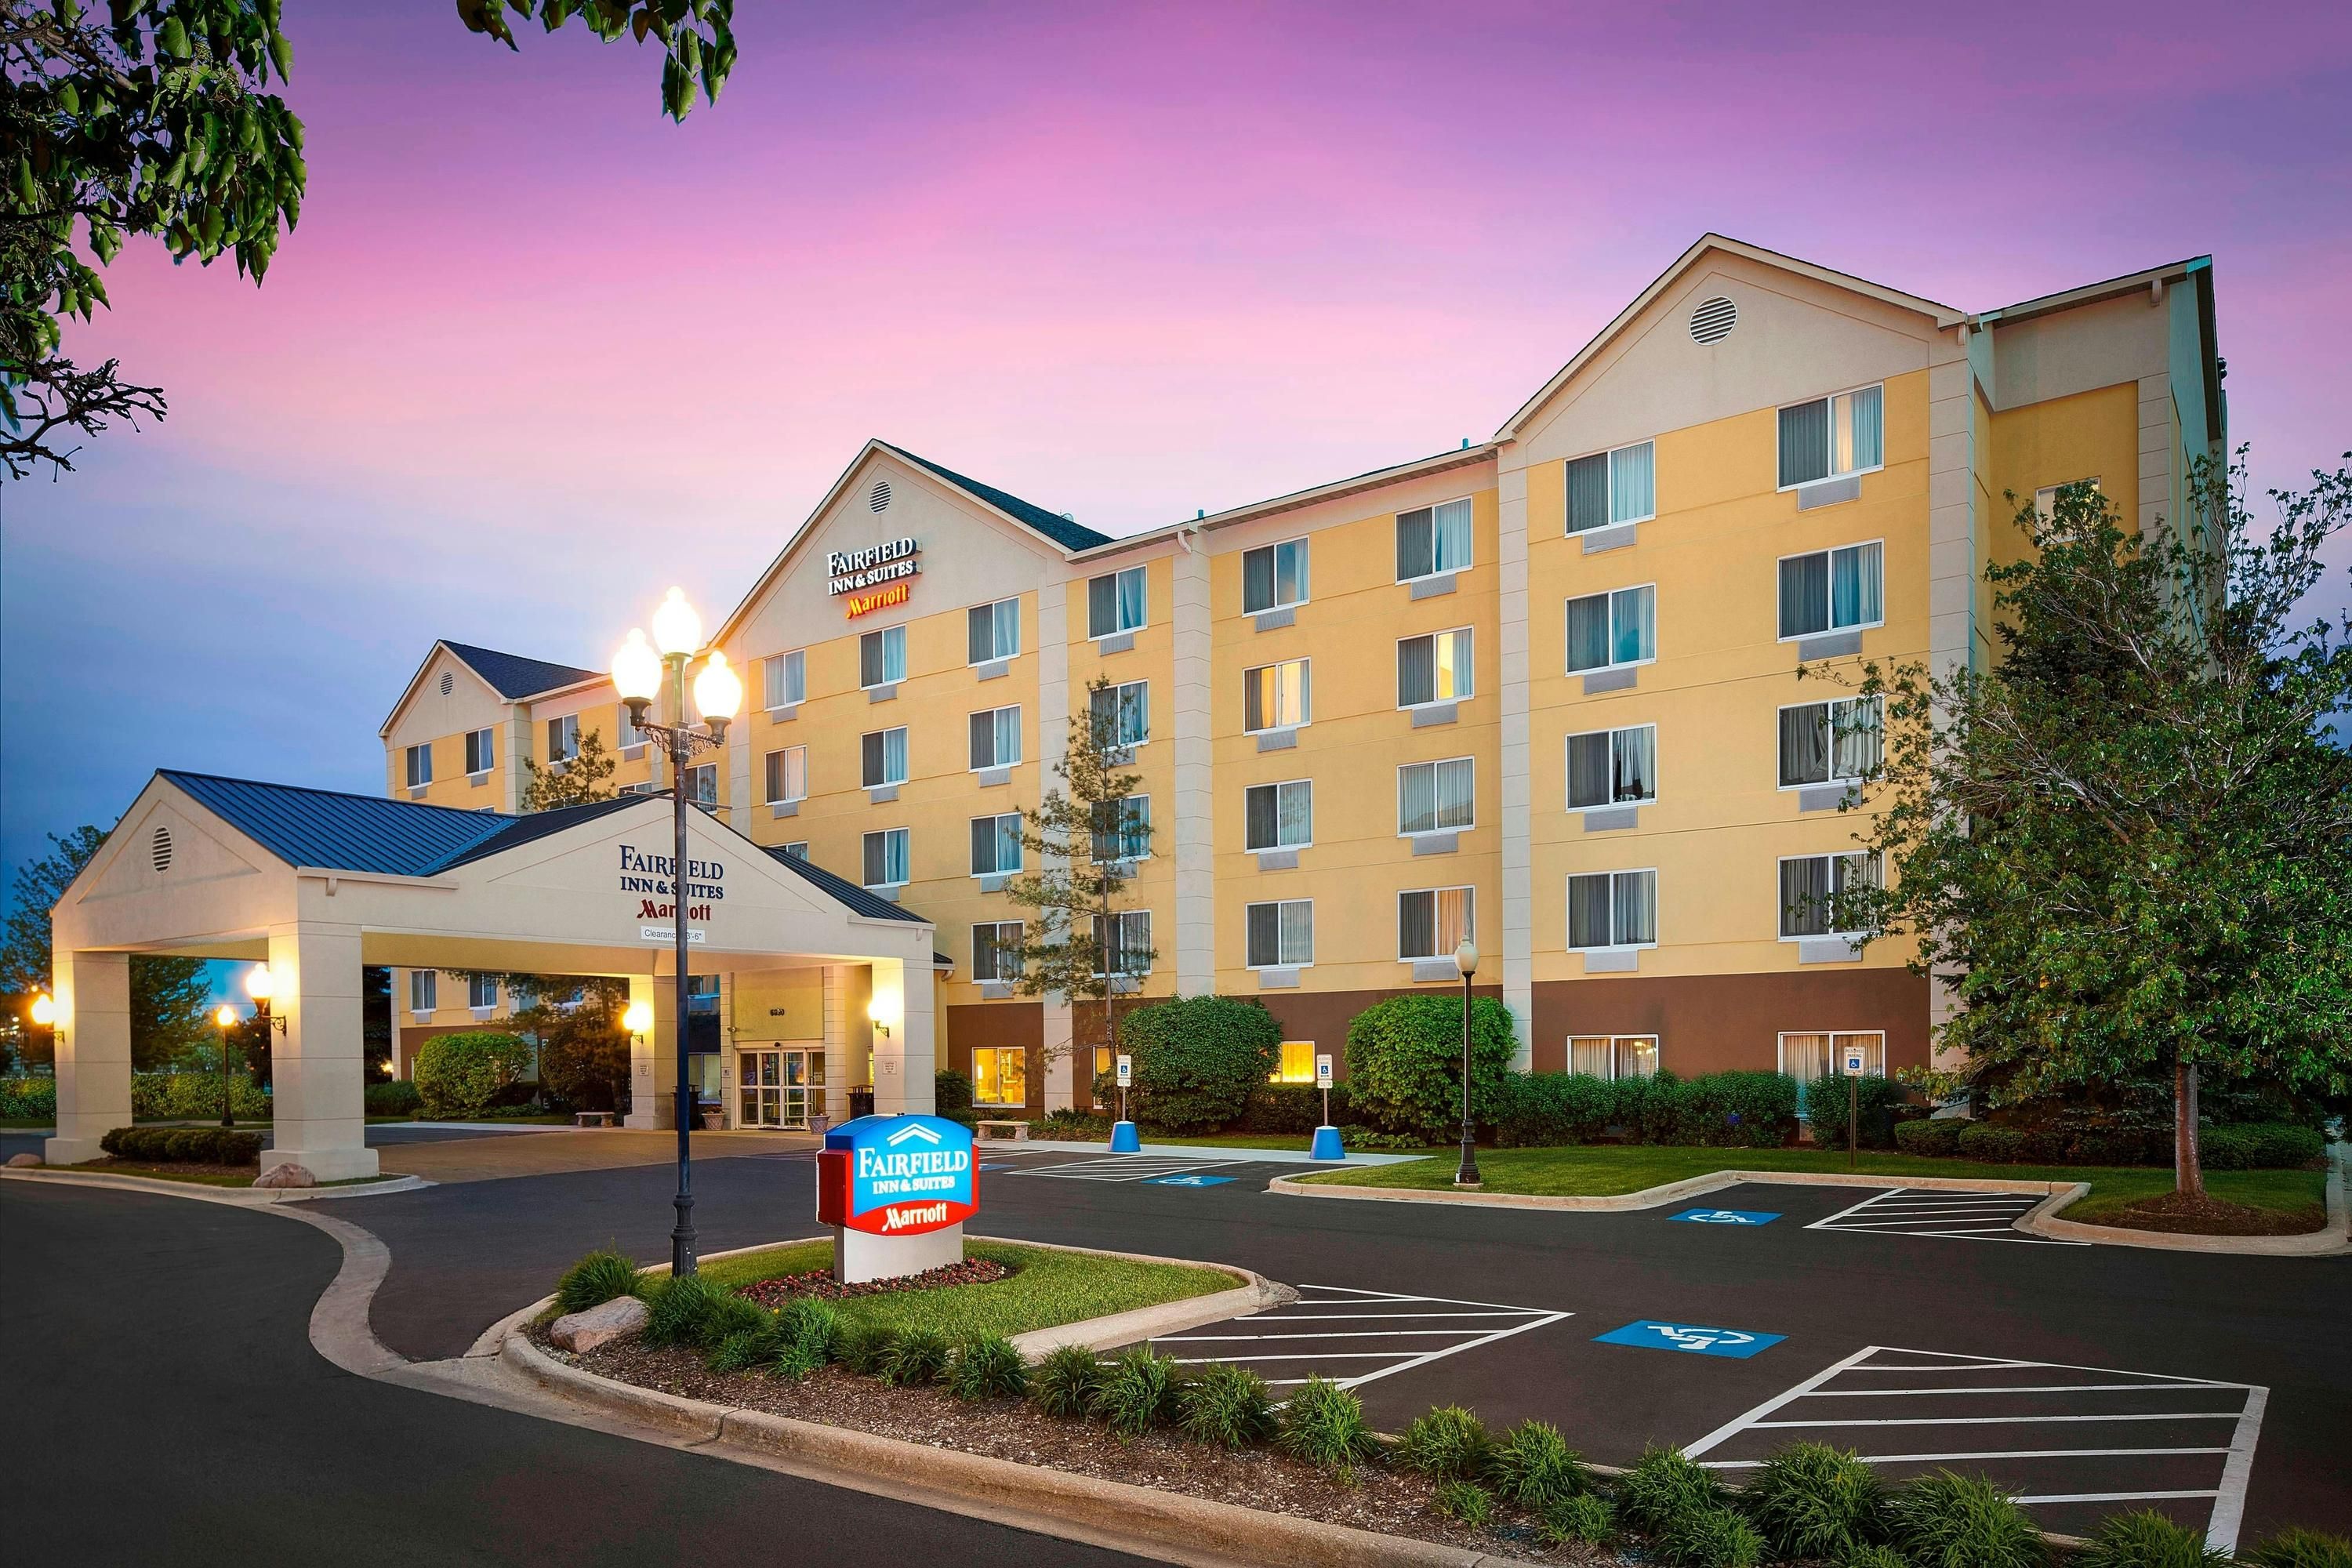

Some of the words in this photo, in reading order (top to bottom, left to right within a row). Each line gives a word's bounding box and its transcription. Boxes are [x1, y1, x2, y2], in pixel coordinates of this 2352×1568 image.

[826, 537, 916, 578] FAIRFIELD
[828, 575, 855, 596] INN
[855, 573, 866, 589] &
[866, 560, 916, 585] SUITES
[845, 583, 909, 619] Marriott
[619, 844, 724, 880] FAIRFELD
[620, 876, 654, 893] INN
[655, 880, 670, 895] &
[637, 899, 711, 920] Marott
[644, 928, 677, 939] Clearanc
[858, 1148, 968, 1178] FAIRFIELD
[873, 1178, 900, 1195] INN
[900, 1179, 911, 1192] &
[912, 1175, 956, 1192] SUITES
[881, 1202, 947, 1232] Marriott
